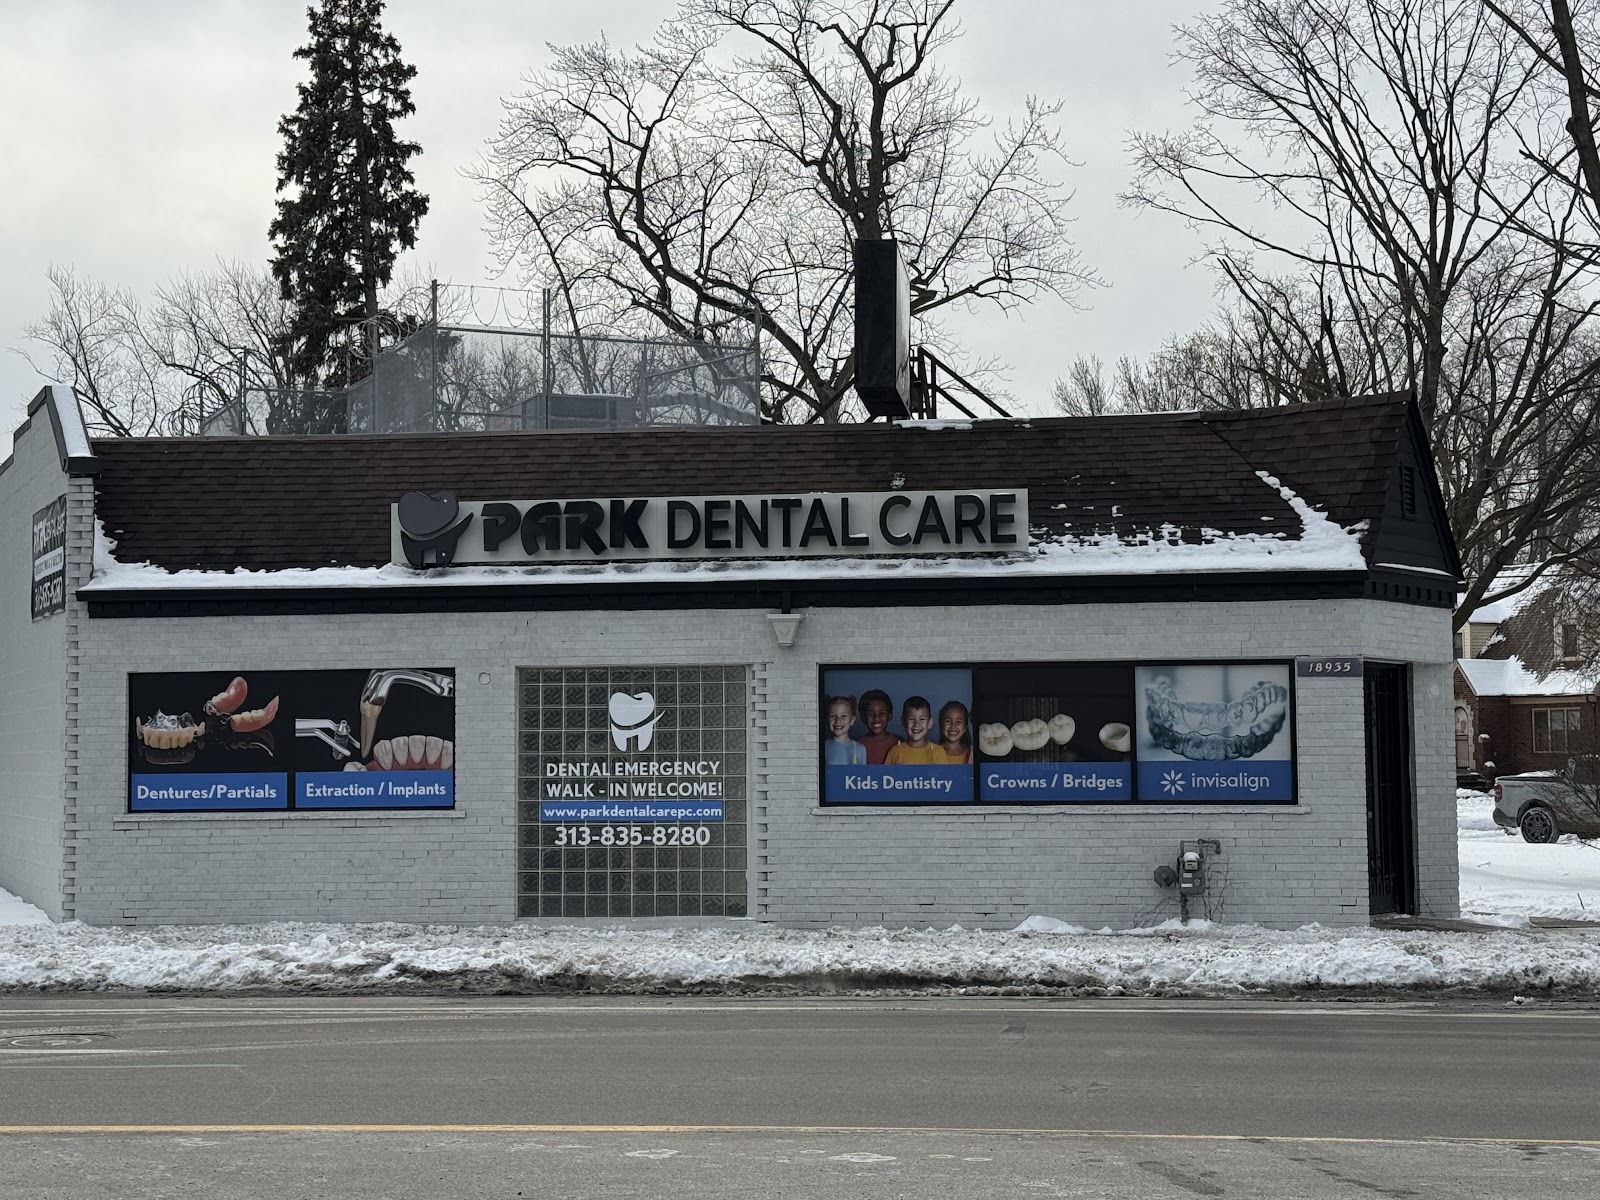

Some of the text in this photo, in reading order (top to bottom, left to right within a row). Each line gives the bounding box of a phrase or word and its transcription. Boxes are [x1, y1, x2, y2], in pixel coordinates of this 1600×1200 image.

[480, 493, 1017, 556] PARK DENTAL CARE
[1308, 662, 1351, 673] 18935
[546, 761, 720, 777] DENTAL EMERGENCY
[306, 782, 446, 799] Extraction / Implants
[546, 783, 595, 798] WALK
[609, 783, 627, 797] IN
[631, 781, 723, 797] WELCOME!
[845, 775, 953, 793] Kids Dentistry
[987, 773, 1123, 791] Crowns / Bridges
[1191, 772, 1270, 792] invisalign
[137, 784, 277, 800] Dentures/Partials
[544, 804, 722, 820] www.parkdentalcarepc.com
[554, 826, 711, 846] 313-835-8280
